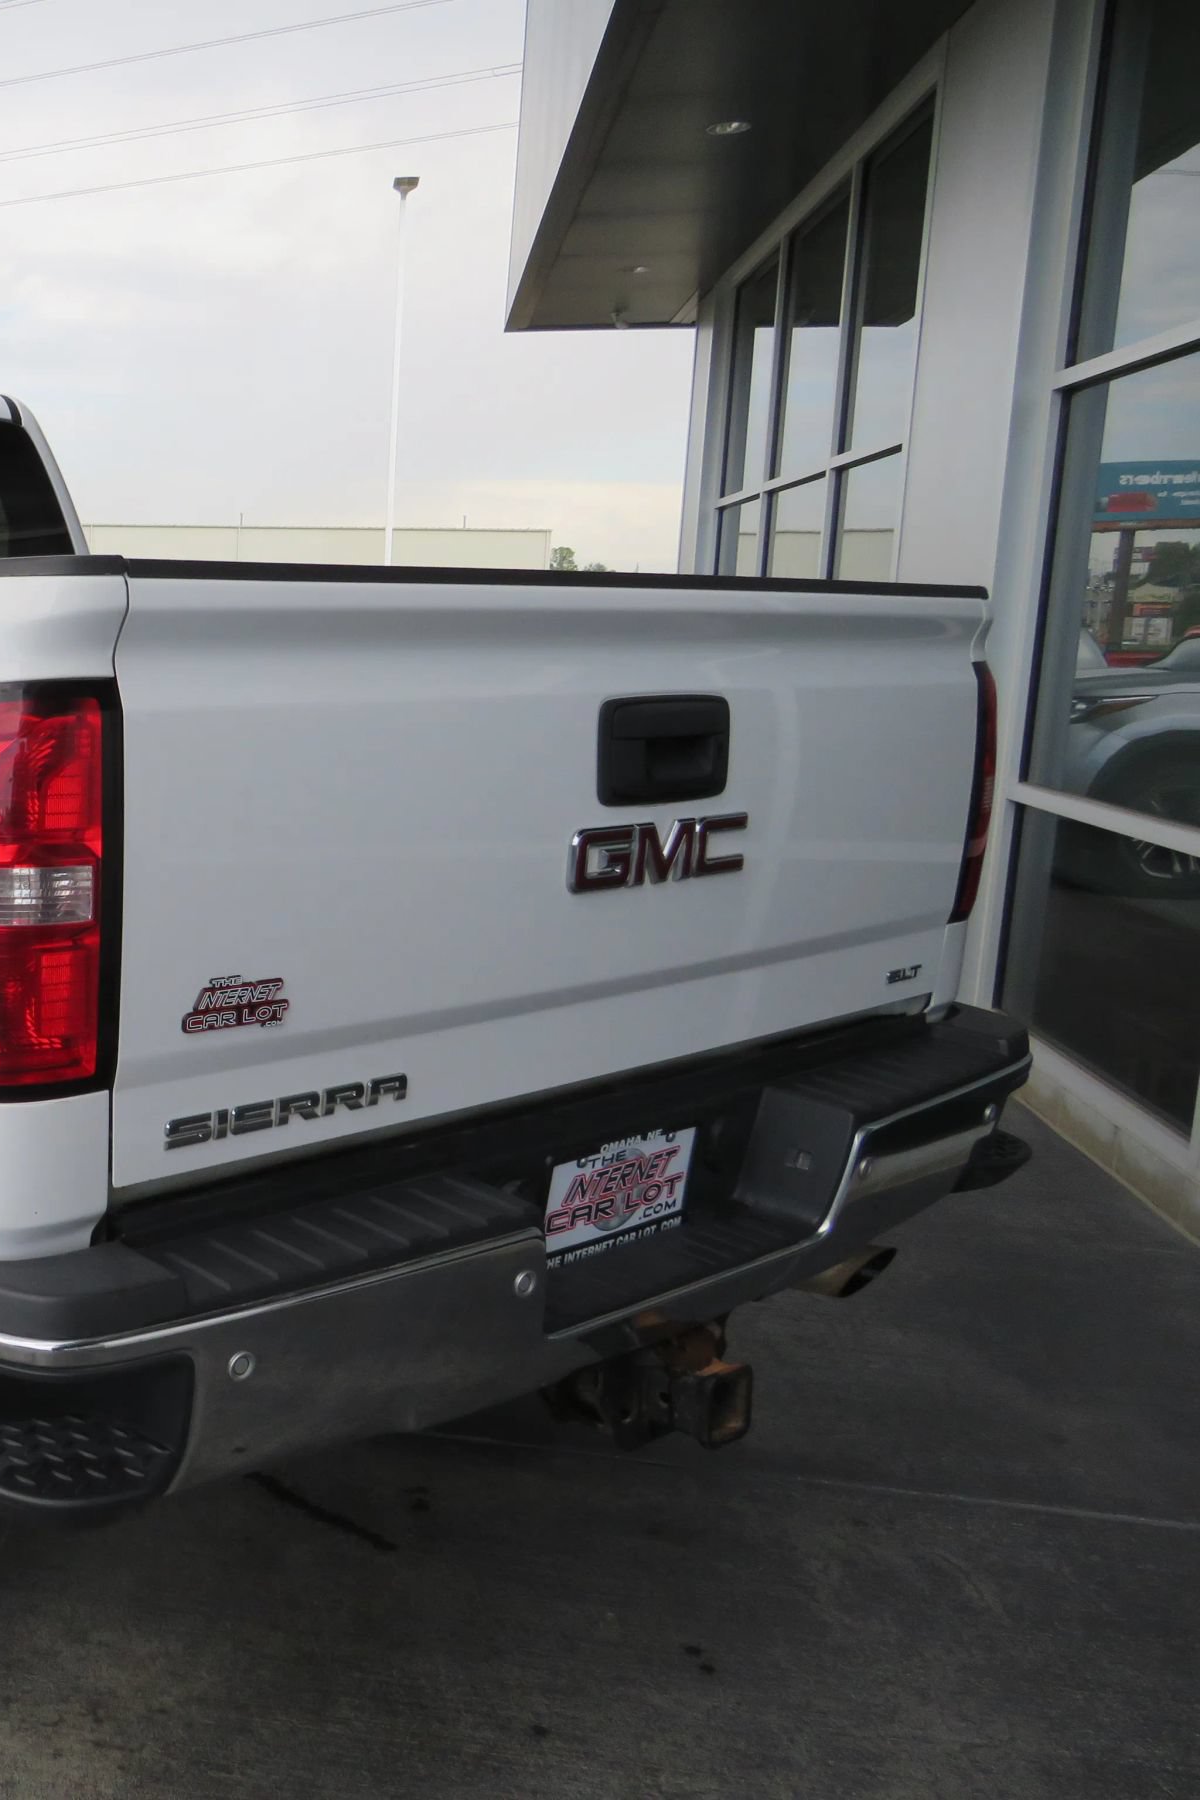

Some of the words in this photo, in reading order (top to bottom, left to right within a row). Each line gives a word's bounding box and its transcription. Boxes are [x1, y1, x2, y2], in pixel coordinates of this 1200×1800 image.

[566, 811, 748, 894] GMC
[198, 981, 283, 1011] INTERNET
[211, 975, 243, 988] THE
[186, 1010, 237, 1031] CAR
[242, 1003, 288, 1023] LOT
[163, 1072, 408, 1151] SIERRA
[561, 1145, 681, 1208] INTERNET
[587, 1150, 627, 1169] THE
[545, 1196, 616, 1237] CAR
[623, 1172, 685, 1214] LOT
[638, 1198, 678, 1221] .COM
[547, 1255, 562, 1270] HE
[564, 1239, 615, 1264] INTERNET
[615, 1230, 636, 1246] CAR
